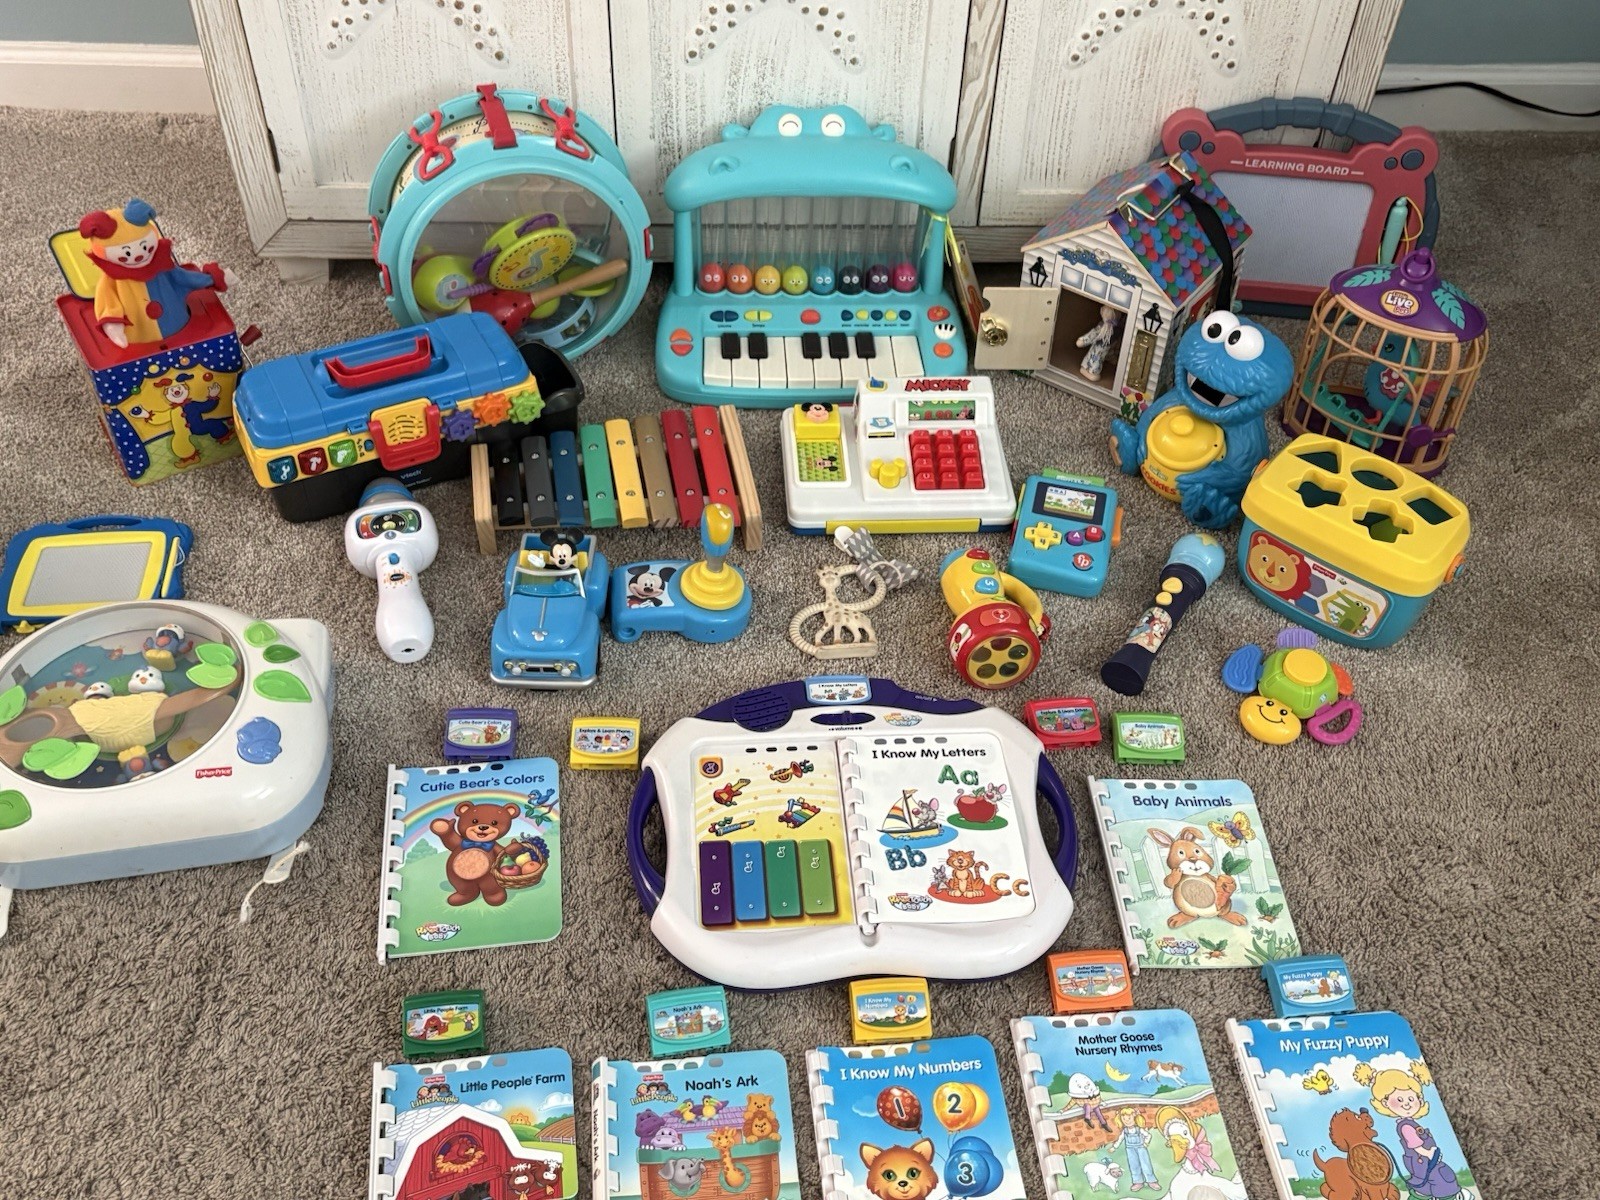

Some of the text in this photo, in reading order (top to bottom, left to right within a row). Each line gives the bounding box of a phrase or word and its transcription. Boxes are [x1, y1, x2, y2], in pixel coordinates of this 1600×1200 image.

[1244, 158, 1350, 176] LEARNING BOARD
[1385, 293, 1414, 309] Live
[905, 379, 971, 393] MICKEY
[1077, 554, 1090, 567] fp
[985, 579, 995, 587] 3
[872, 748, 987, 760] I Know My Letters
[420, 773, 545, 793] Cutie Bear's Colors
[937, 764, 980, 786] Aa
[1132, 795, 1233, 809] Baby Animals
[885, 844, 927, 871] Bb
[989, 872, 1030, 897] Cc
[1078, 1031, 1155, 1046] Mother Goose
[1279, 1034, 1390, 1054] My Fuzzy Puppy
[1075, 1042, 1163, 1058] Nursery Rhymes
[840, 1058, 982, 1081] I Know My Numbers
[460, 1073, 566, 1093] Little People Farm
[685, 1075, 759, 1092] Noah's Ark
[432, 1094, 459, 1105] People
[651, 1092, 678, 1103] People
[947, 1093, 962, 1114] 2
[893, 1097, 906, 1120] 1
[956, 1162, 974, 1186] 3
